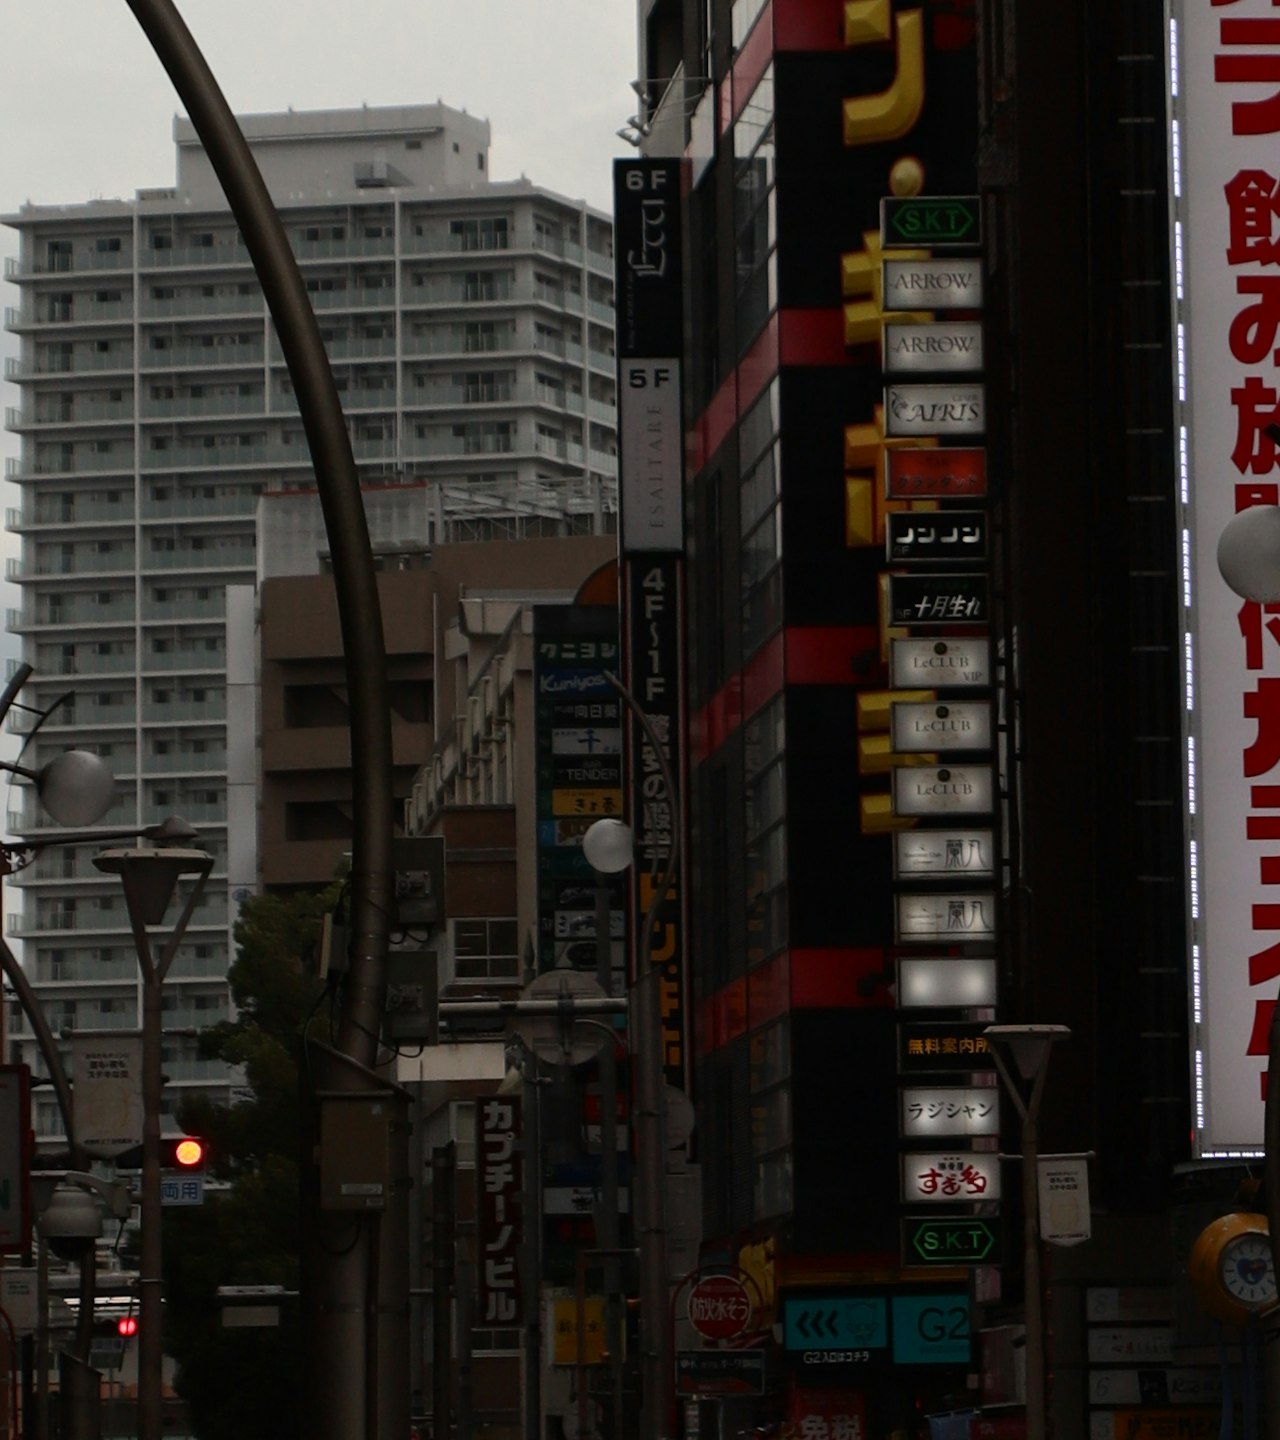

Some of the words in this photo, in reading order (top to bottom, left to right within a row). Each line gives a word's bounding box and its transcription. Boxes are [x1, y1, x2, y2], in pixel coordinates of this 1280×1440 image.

[625, 168, 668, 193] 6F
[894, 272, 972, 289] ARROW
[895, 336, 974, 353] ARROW
[629, 369, 671, 390] 5F
[649, 403, 665, 528] ESALTARE
[539, 641, 617, 660] クニヨシ
[913, 657, 969, 668] LeCLUB
[914, 720, 971, 732] LeCLUB
[916, 784, 974, 796] LeCLUB
[908, 1101, 995, 1121] ラジシャン
[481, 1100, 519, 1321] カプチーノビル
[923, 1230, 984, 1252] S.K.T
[692, 1296, 749, 1321] 防火水そう
[915, 1306, 971, 1343] G2
